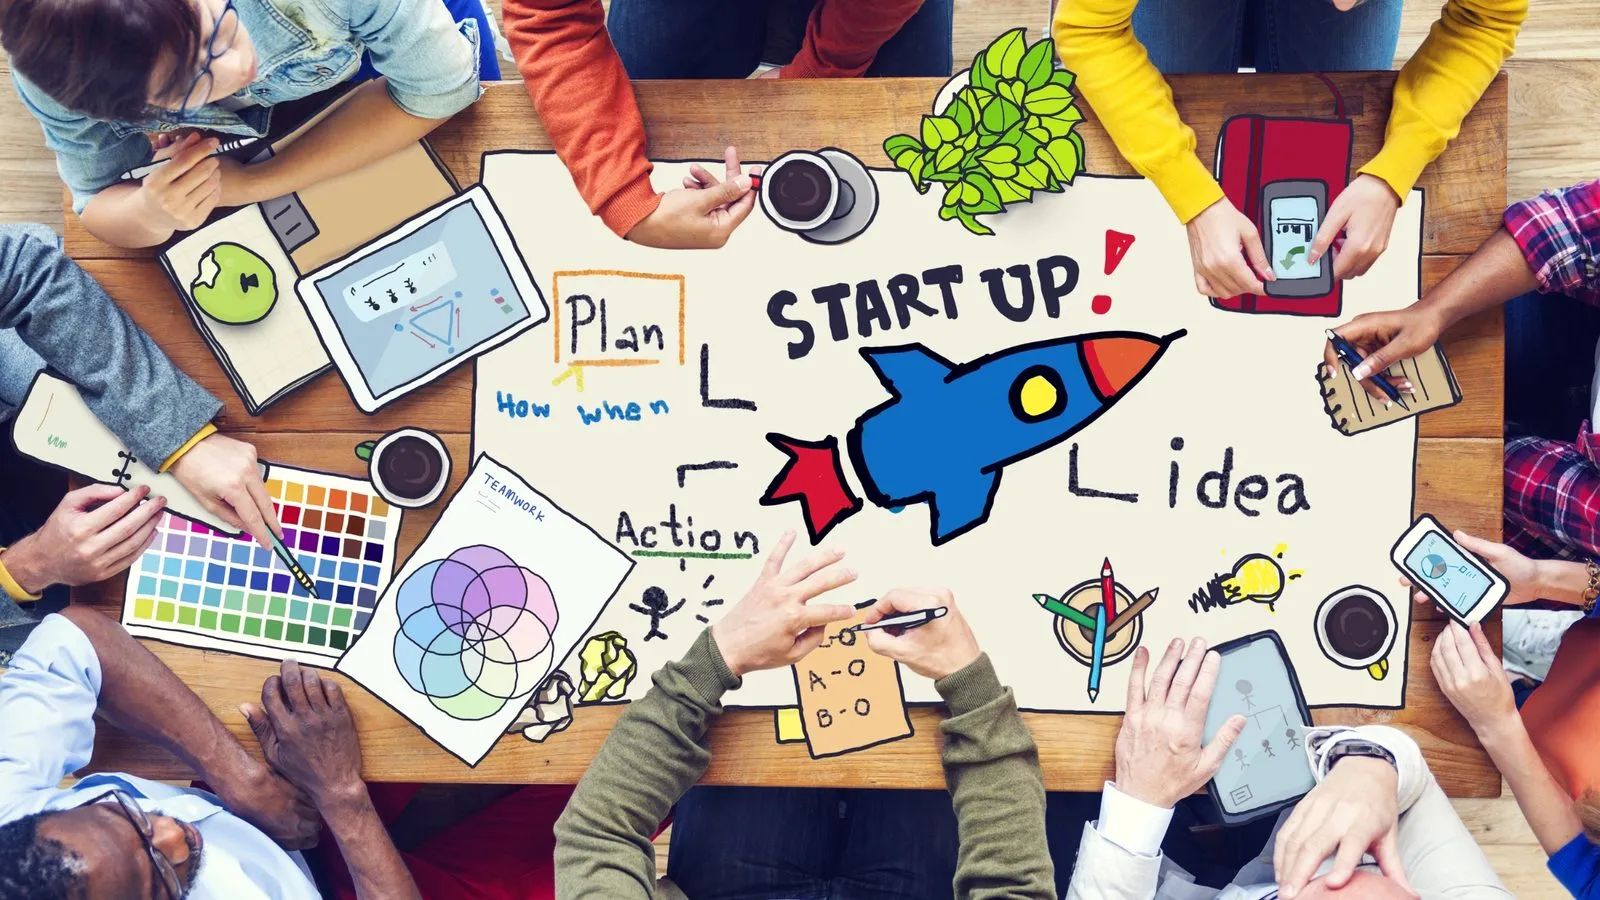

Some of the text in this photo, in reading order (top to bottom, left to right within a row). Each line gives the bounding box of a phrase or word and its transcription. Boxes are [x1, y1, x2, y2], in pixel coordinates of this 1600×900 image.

[565, 294, 664, 354] Plan
[766, 264, 963, 360] START
[496, 391, 669, 425] How when
[484, 472, 545, 522] TEAMWORK
[1168, 436, 1311, 517] idea
[614, 503, 760, 555] Action
